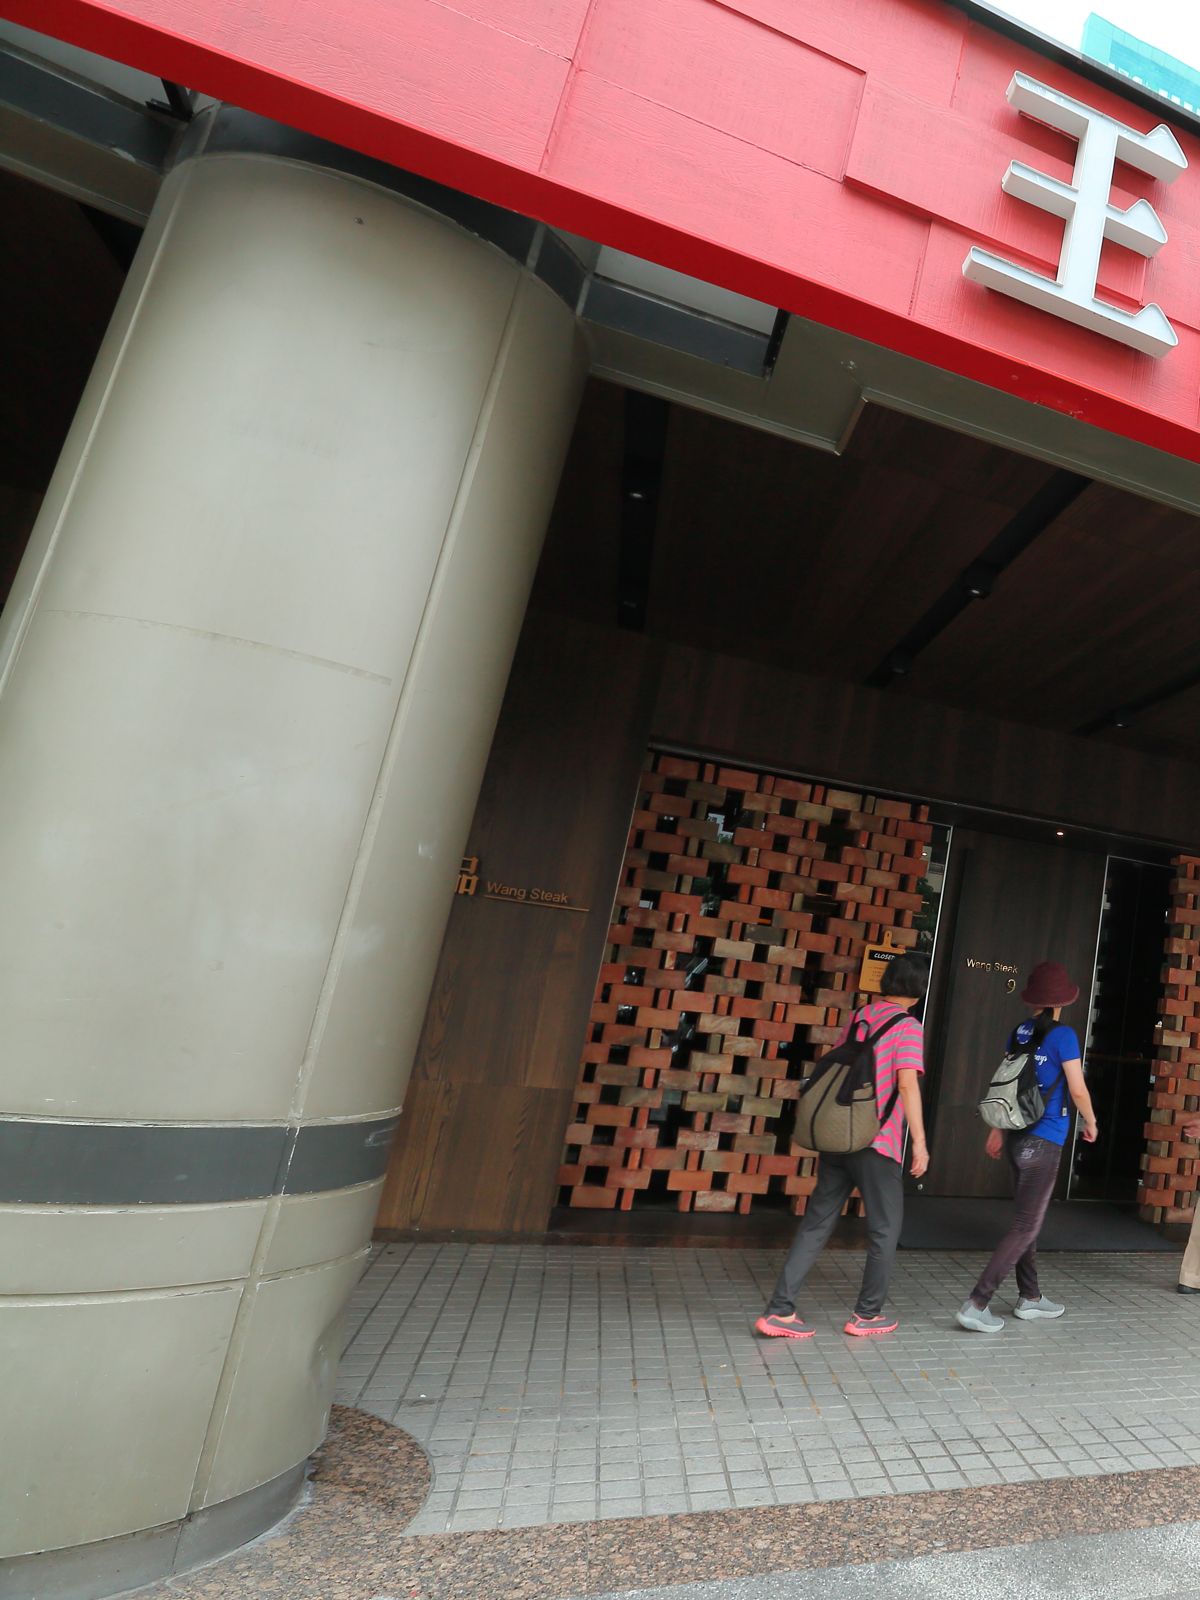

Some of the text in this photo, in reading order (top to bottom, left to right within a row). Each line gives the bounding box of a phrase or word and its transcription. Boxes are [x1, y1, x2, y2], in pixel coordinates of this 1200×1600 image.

[487, 881, 568, 904] Wang Steak
[966, 958, 1018, 974] Wang Steak
